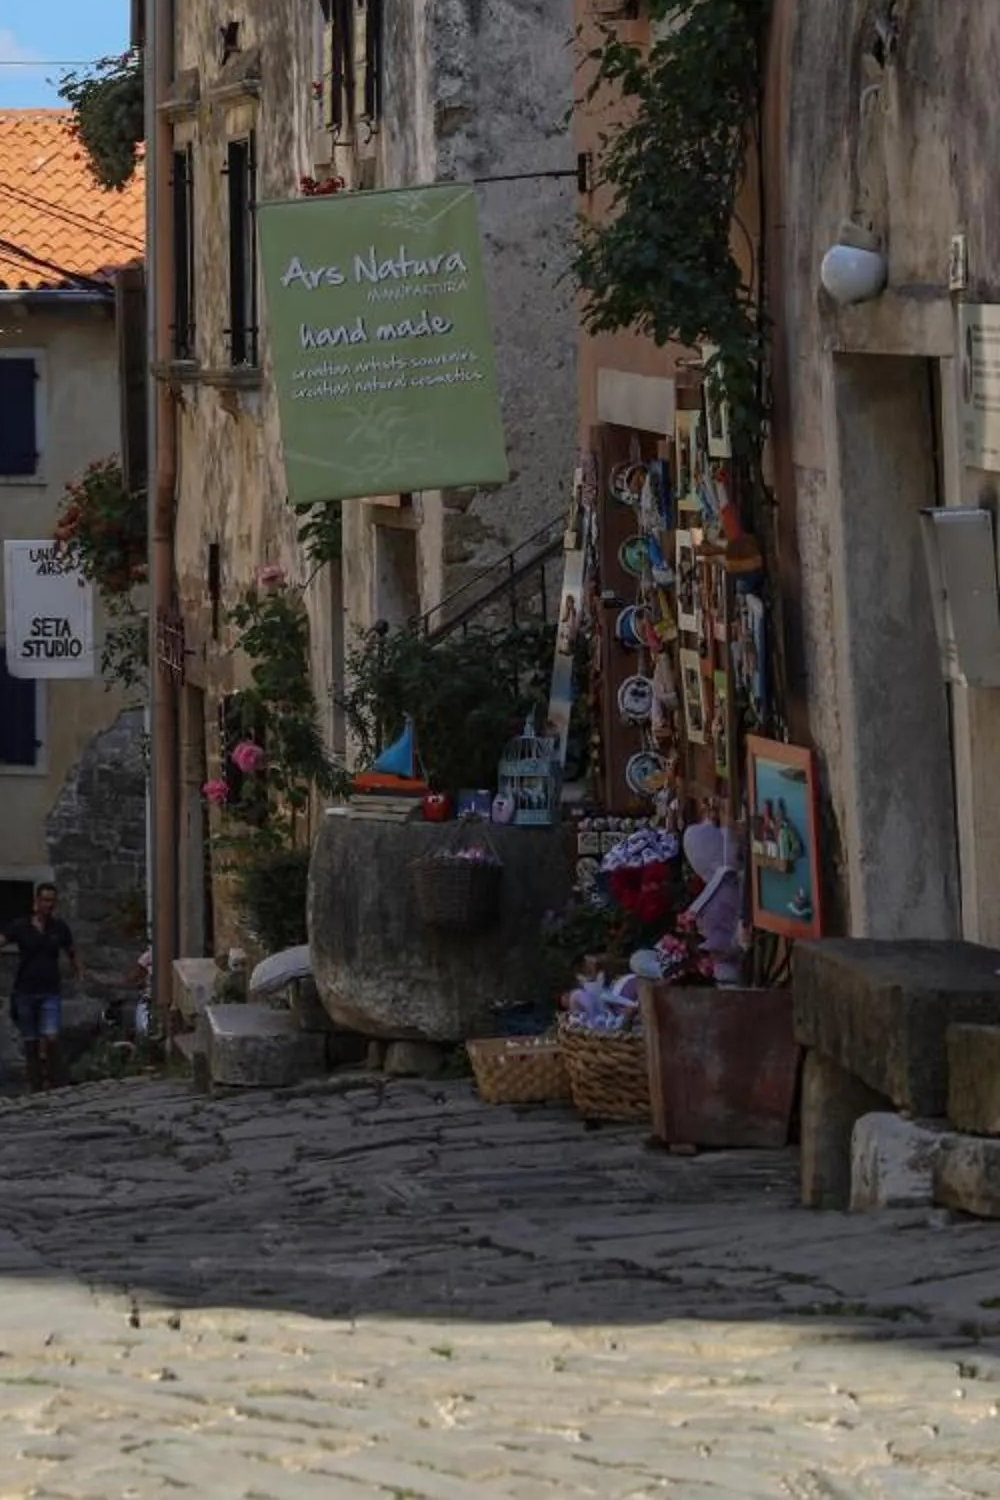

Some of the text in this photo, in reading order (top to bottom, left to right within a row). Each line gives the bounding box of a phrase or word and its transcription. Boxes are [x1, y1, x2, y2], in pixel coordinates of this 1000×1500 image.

[280, 244, 468, 290] Ars Natura
[299, 309, 453, 349] hand made
[354, 373, 406, 393] natural
[30, 617, 72, 637] SETA
[21, 638, 82, 658] STUDIO
